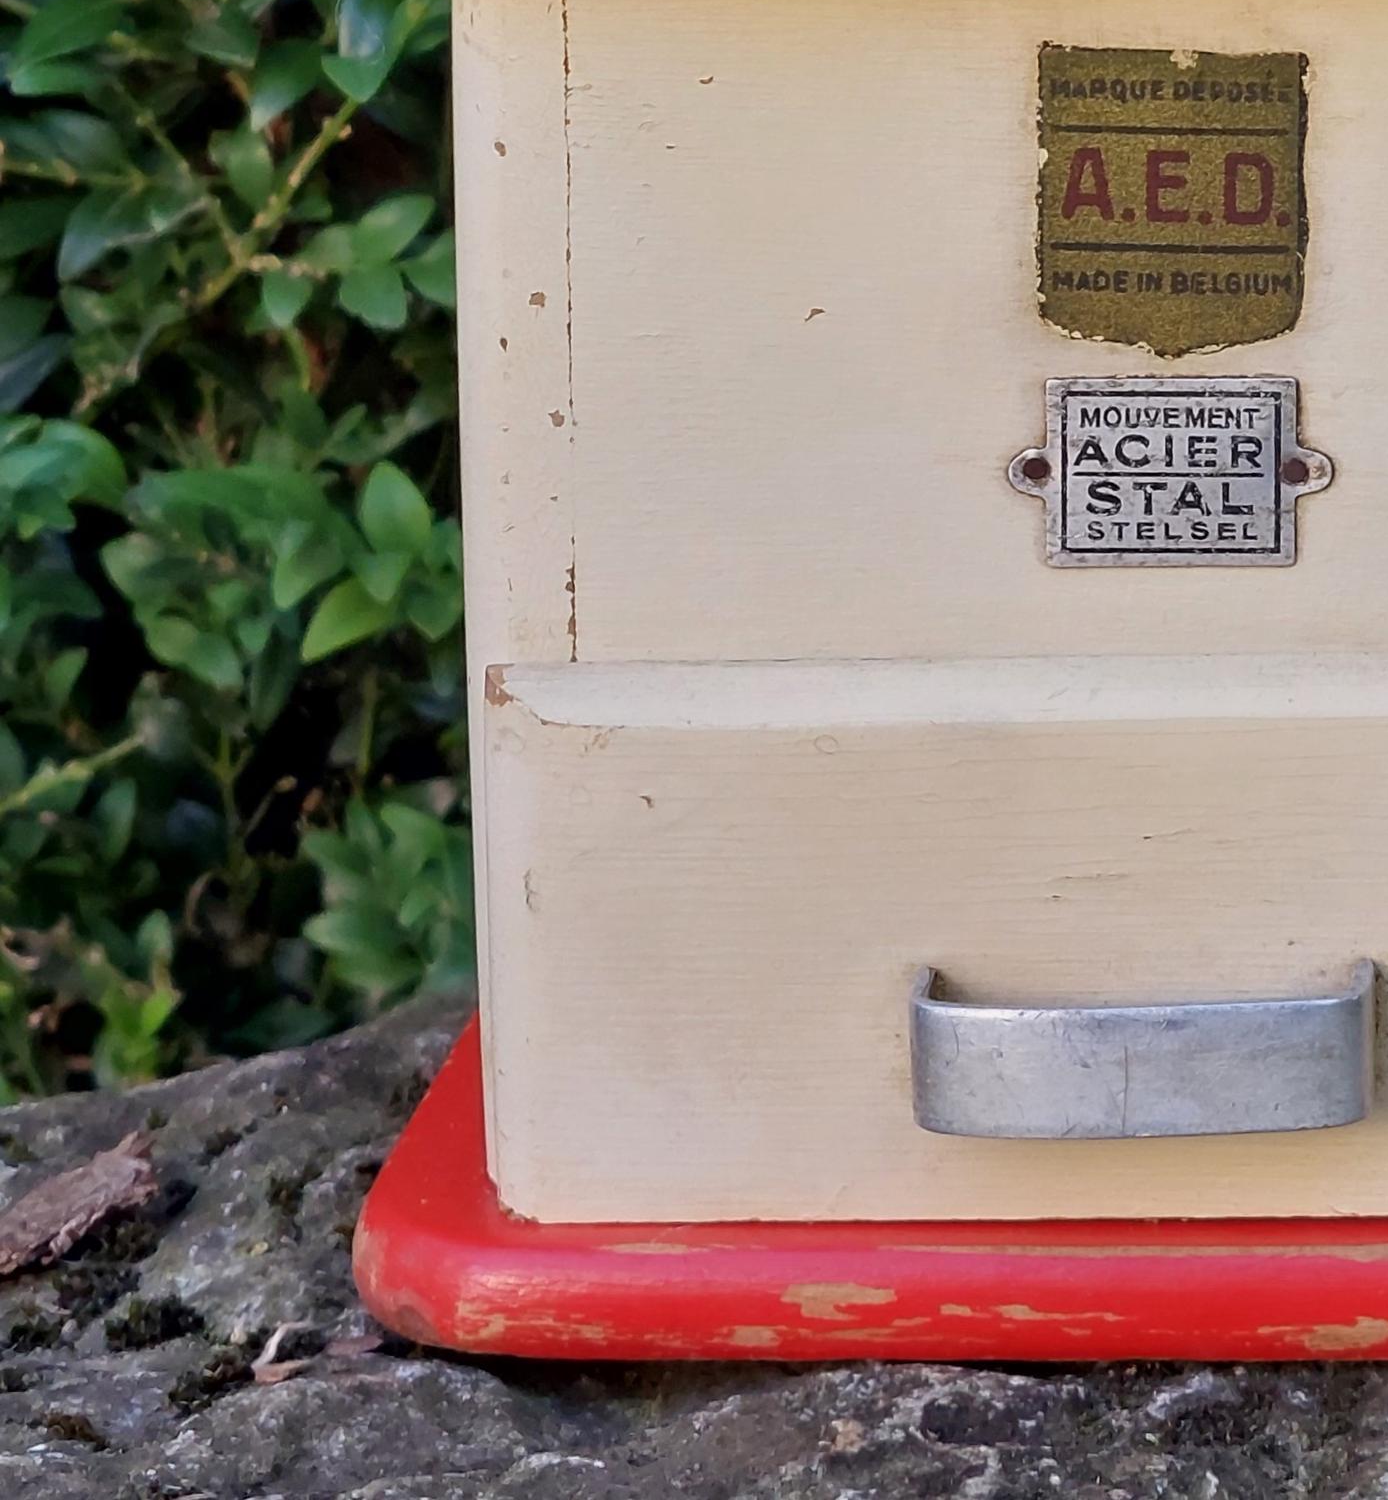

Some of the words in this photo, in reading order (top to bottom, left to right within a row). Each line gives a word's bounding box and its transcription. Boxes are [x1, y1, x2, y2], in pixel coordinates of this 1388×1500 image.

[1051, 79, 1165, 103] MARQUE
[1062, 146, 1291, 225] A.E.D.
[1053, 270, 1129, 293] MADE
[1137, 272, 1162, 293] IN
[1170, 272, 1292, 295] BELGIUM
[1080, 407, 1260, 429] MOUVEMENT
[1073, 435, 1264, 468] ACIER
[1085, 481, 1254, 516] STAL
[1087, 522, 1258, 541] STELSEL
